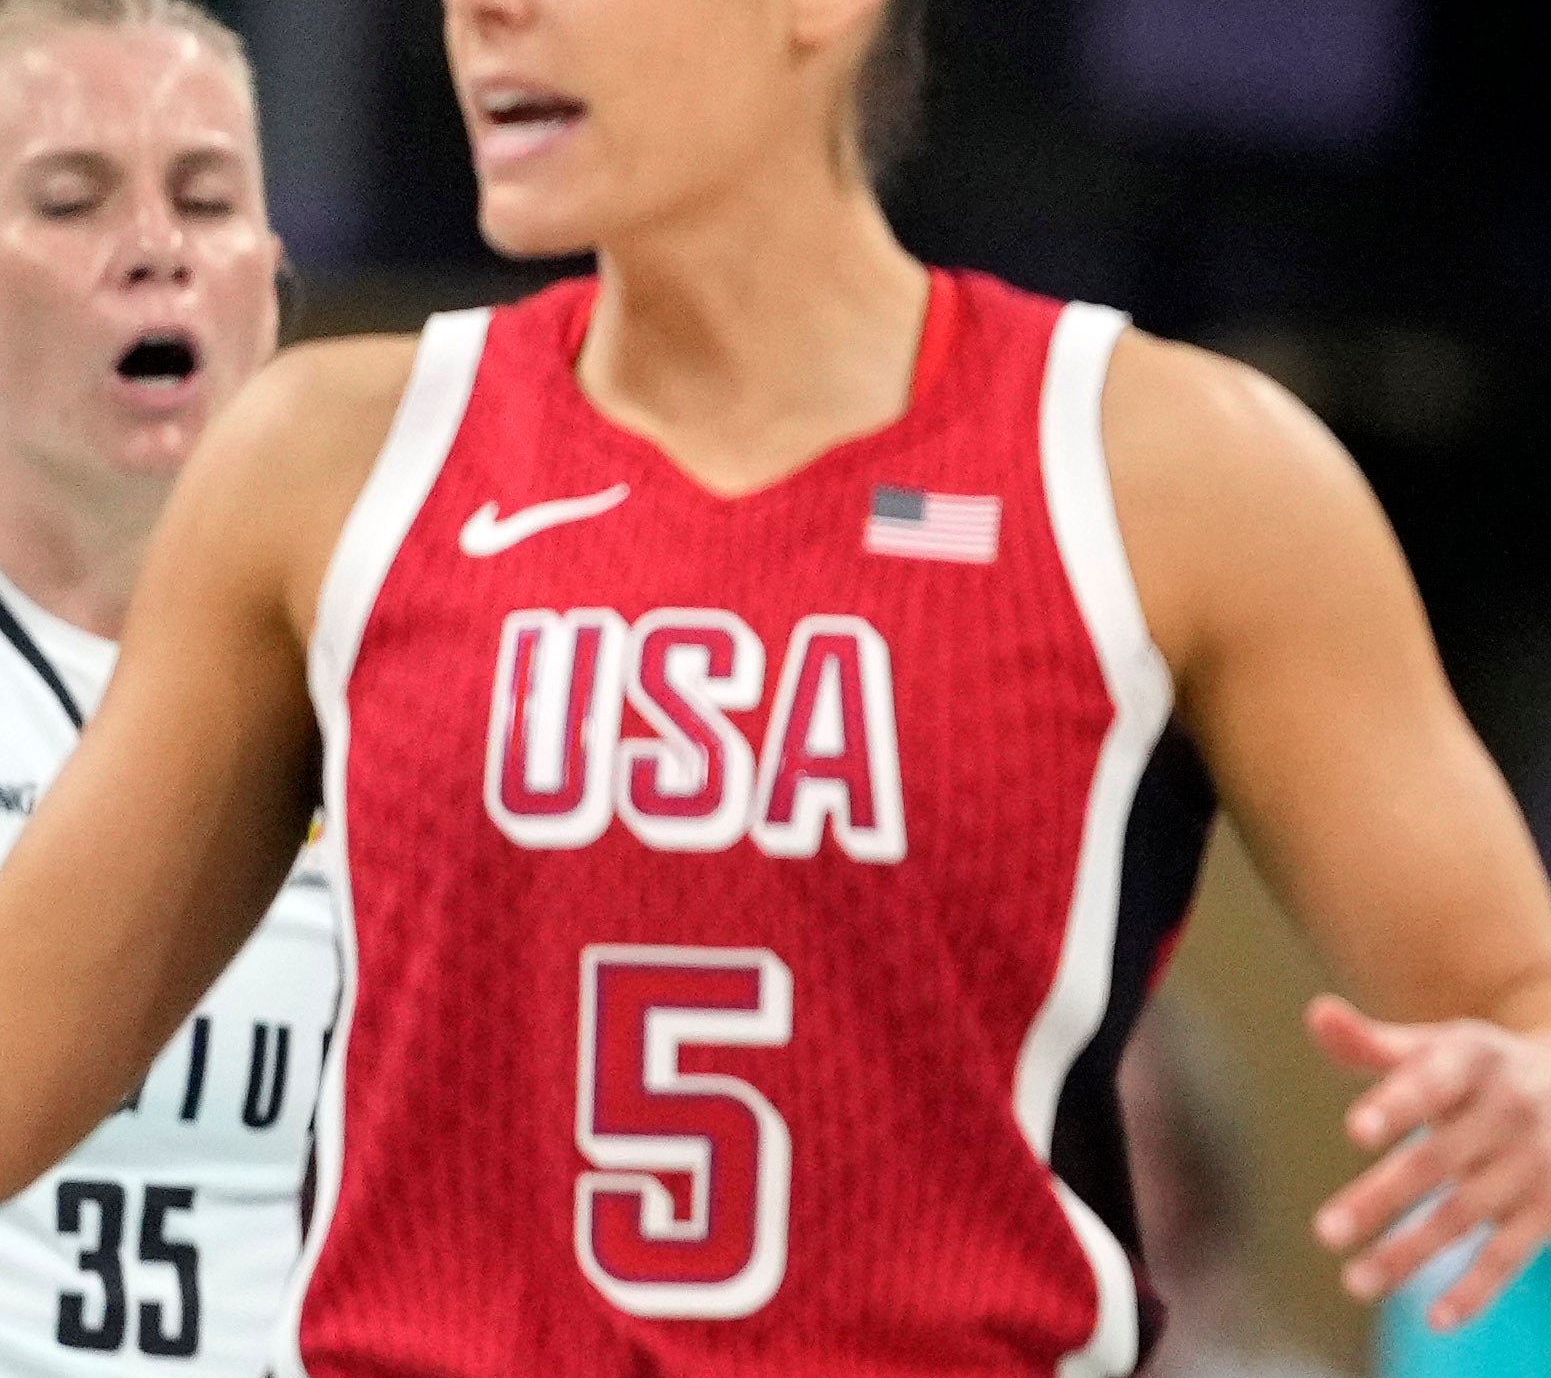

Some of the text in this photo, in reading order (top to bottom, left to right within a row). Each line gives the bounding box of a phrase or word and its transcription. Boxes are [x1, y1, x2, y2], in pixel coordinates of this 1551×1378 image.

[484, 607, 907, 864] USA
[575, 943, 796, 1320] 5
[56, 1179, 200, 1359] 35
